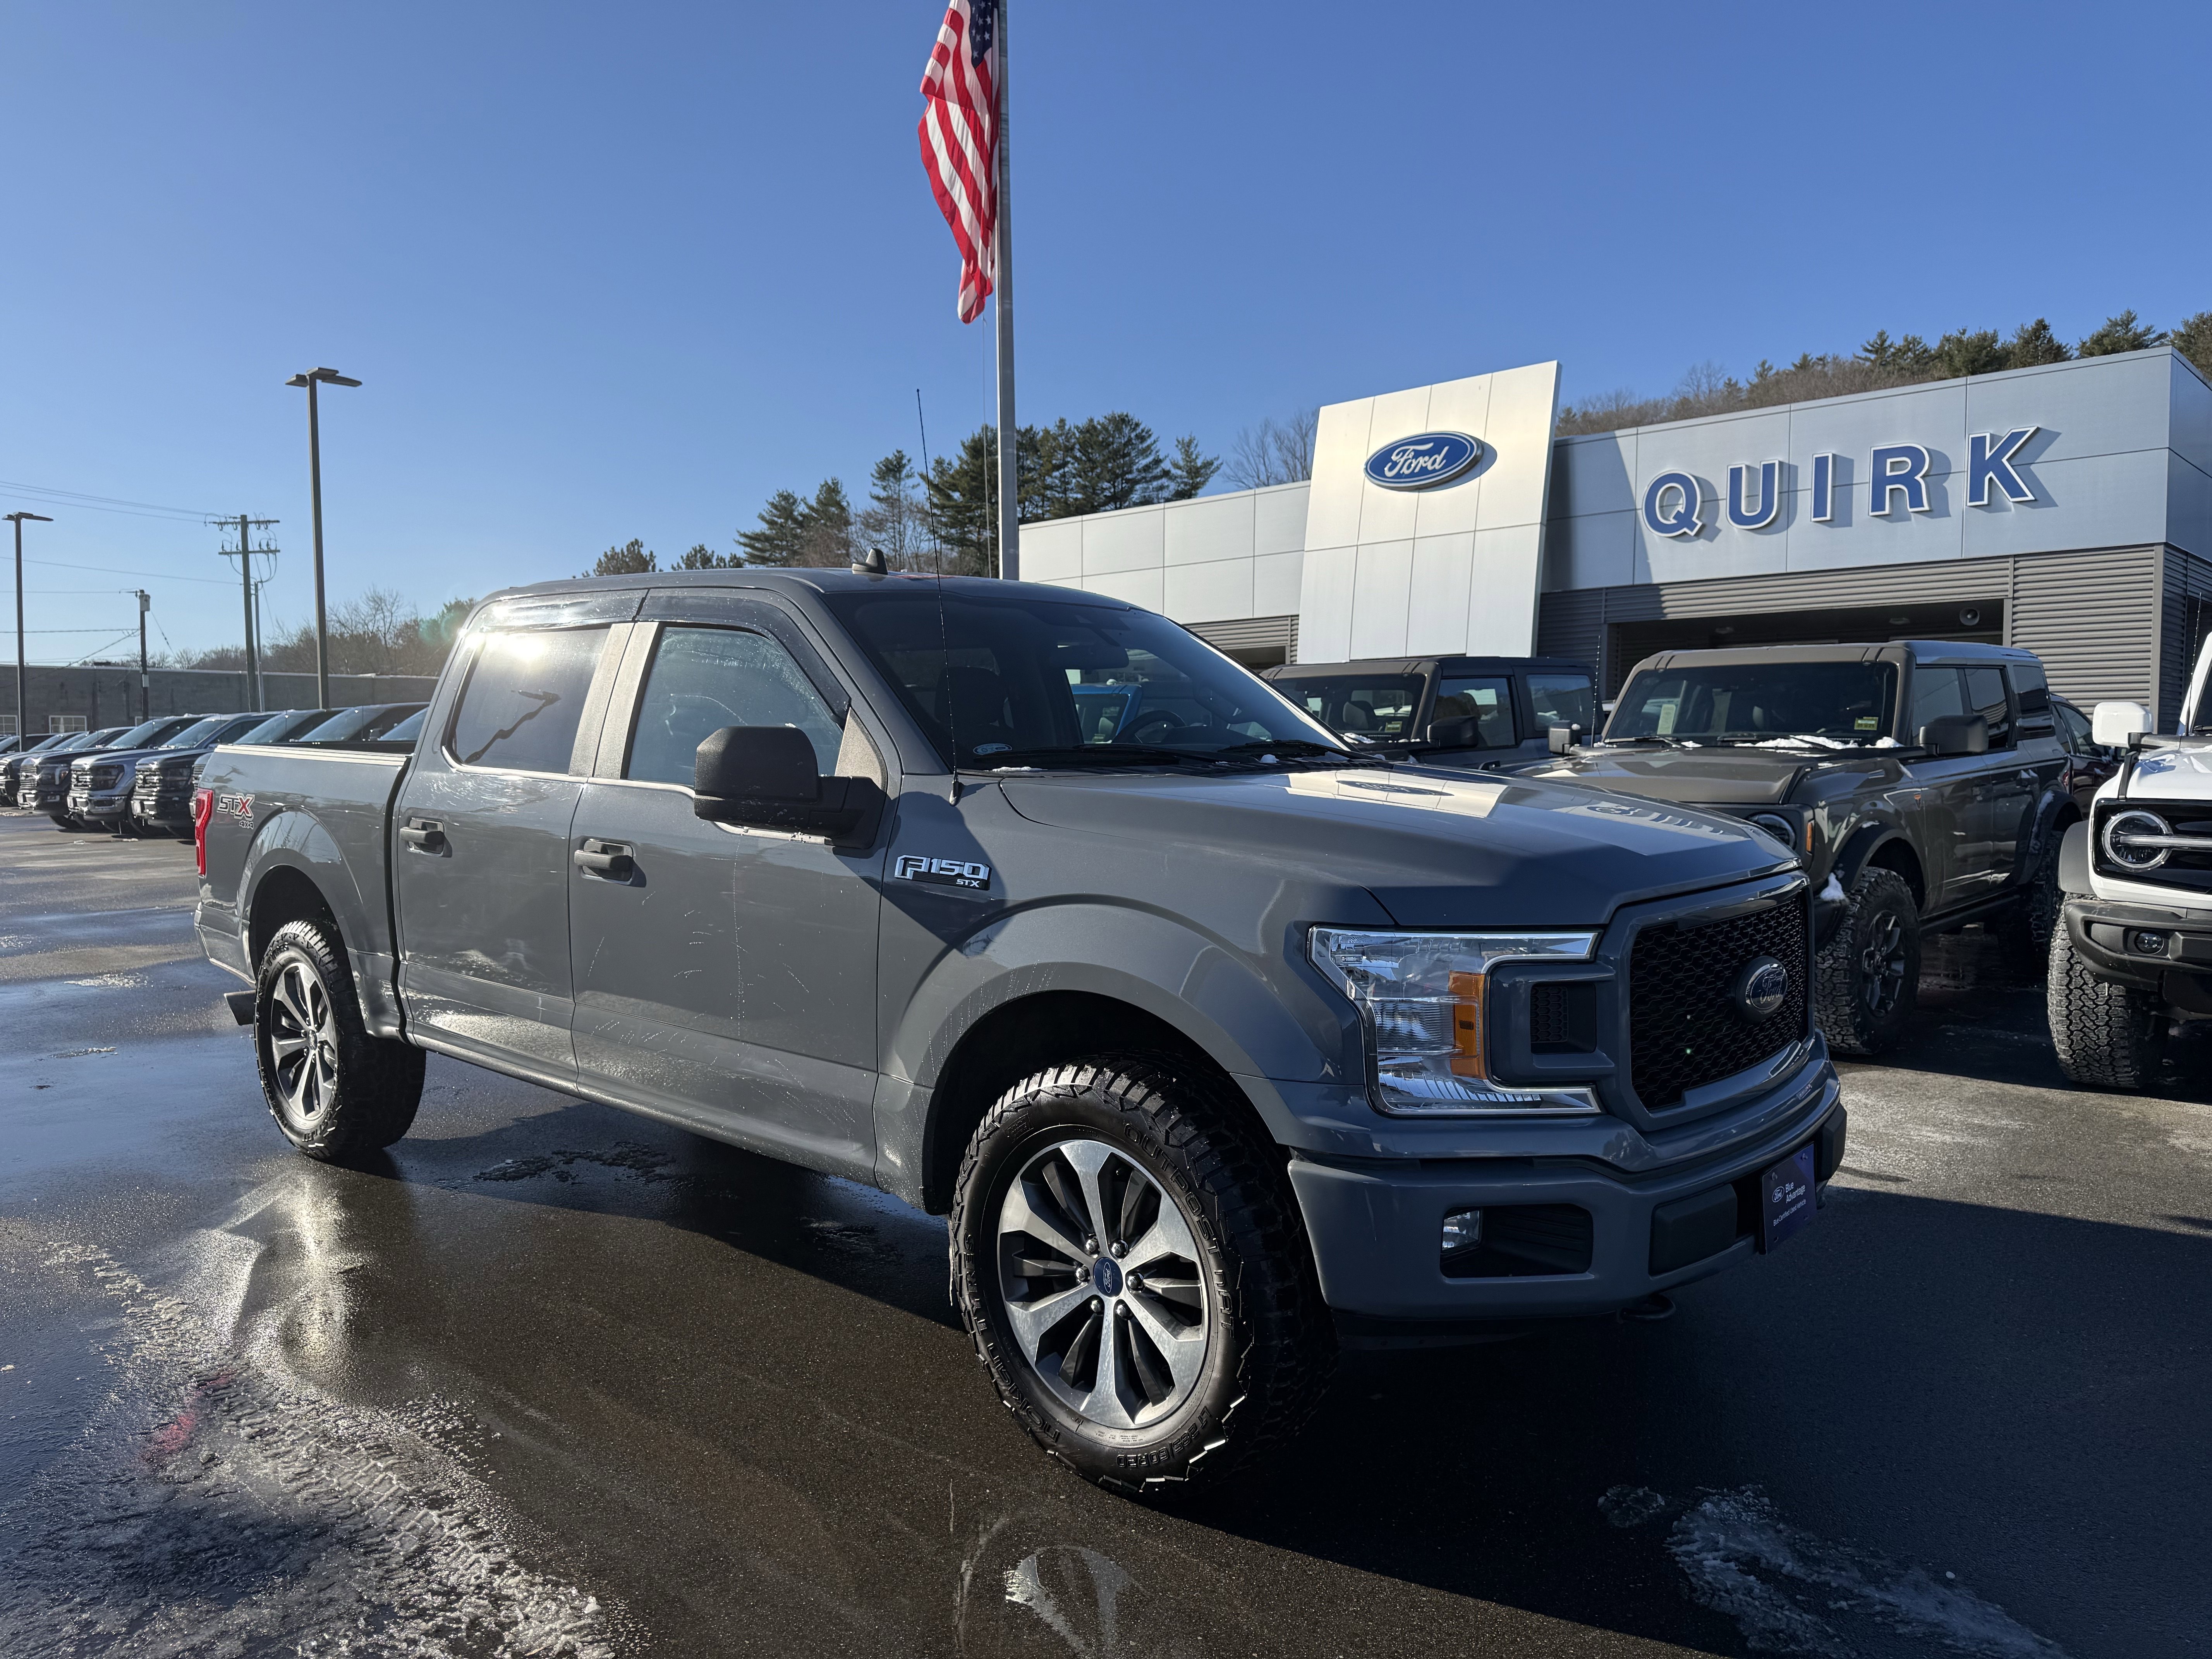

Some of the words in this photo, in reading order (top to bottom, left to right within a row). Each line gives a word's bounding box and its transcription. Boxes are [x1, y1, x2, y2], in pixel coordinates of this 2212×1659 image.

[1384, 442, 1449, 477] Ford
[1642, 426, 2039, 538] QUIRK
[216, 792, 255, 821] STX
[956, 879, 980, 888] STX
[1760, 974, 1784, 1004] Ford
[1124, 1123, 1223, 1259] OUTPOST
[1786, 1182, 1794, 1193] Blue
[1786, 1185, 1805, 1204] Advantage
[1779, 1209, 1790, 1222] Certified
[1797, 1199, 1806, 1209] Vehicle
[1197, 1406, 1212, 1429] LT
